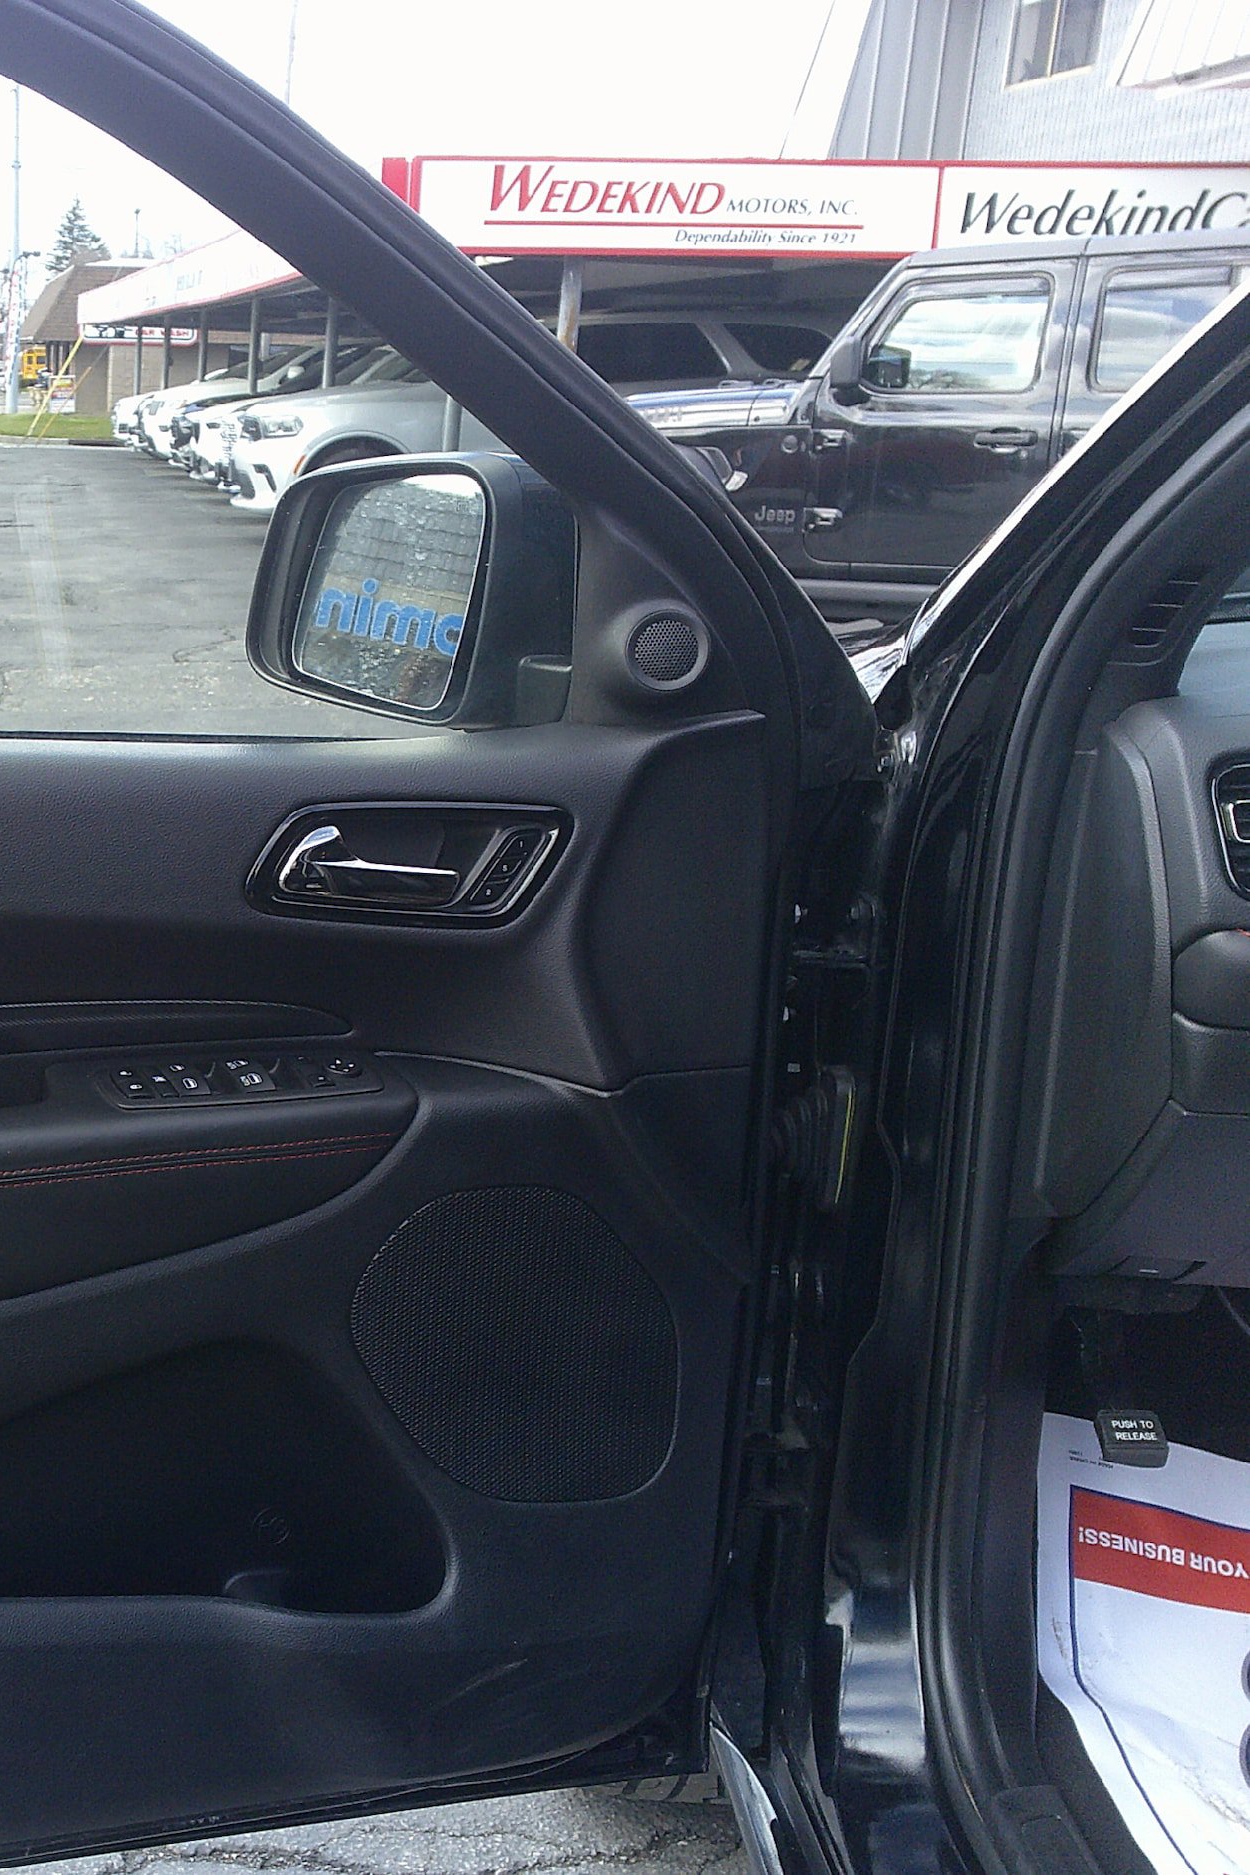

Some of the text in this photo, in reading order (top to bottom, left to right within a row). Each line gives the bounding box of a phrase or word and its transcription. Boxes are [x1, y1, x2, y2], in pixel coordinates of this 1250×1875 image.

[490, 164, 858, 216] WEDEKIND MOTORS, INC.
[960, 188, 1250, 236] WedekindC
[675, 229, 857, 246] Dependability Since 1921
[754, 505, 796, 524] Jeep
[1111, 1419, 1154, 1429] PUSH TO
[1115, 1431, 1158, 1441] RELEASE
[1078, 1526, 1250, 1579] YOUR BUSINESS!
